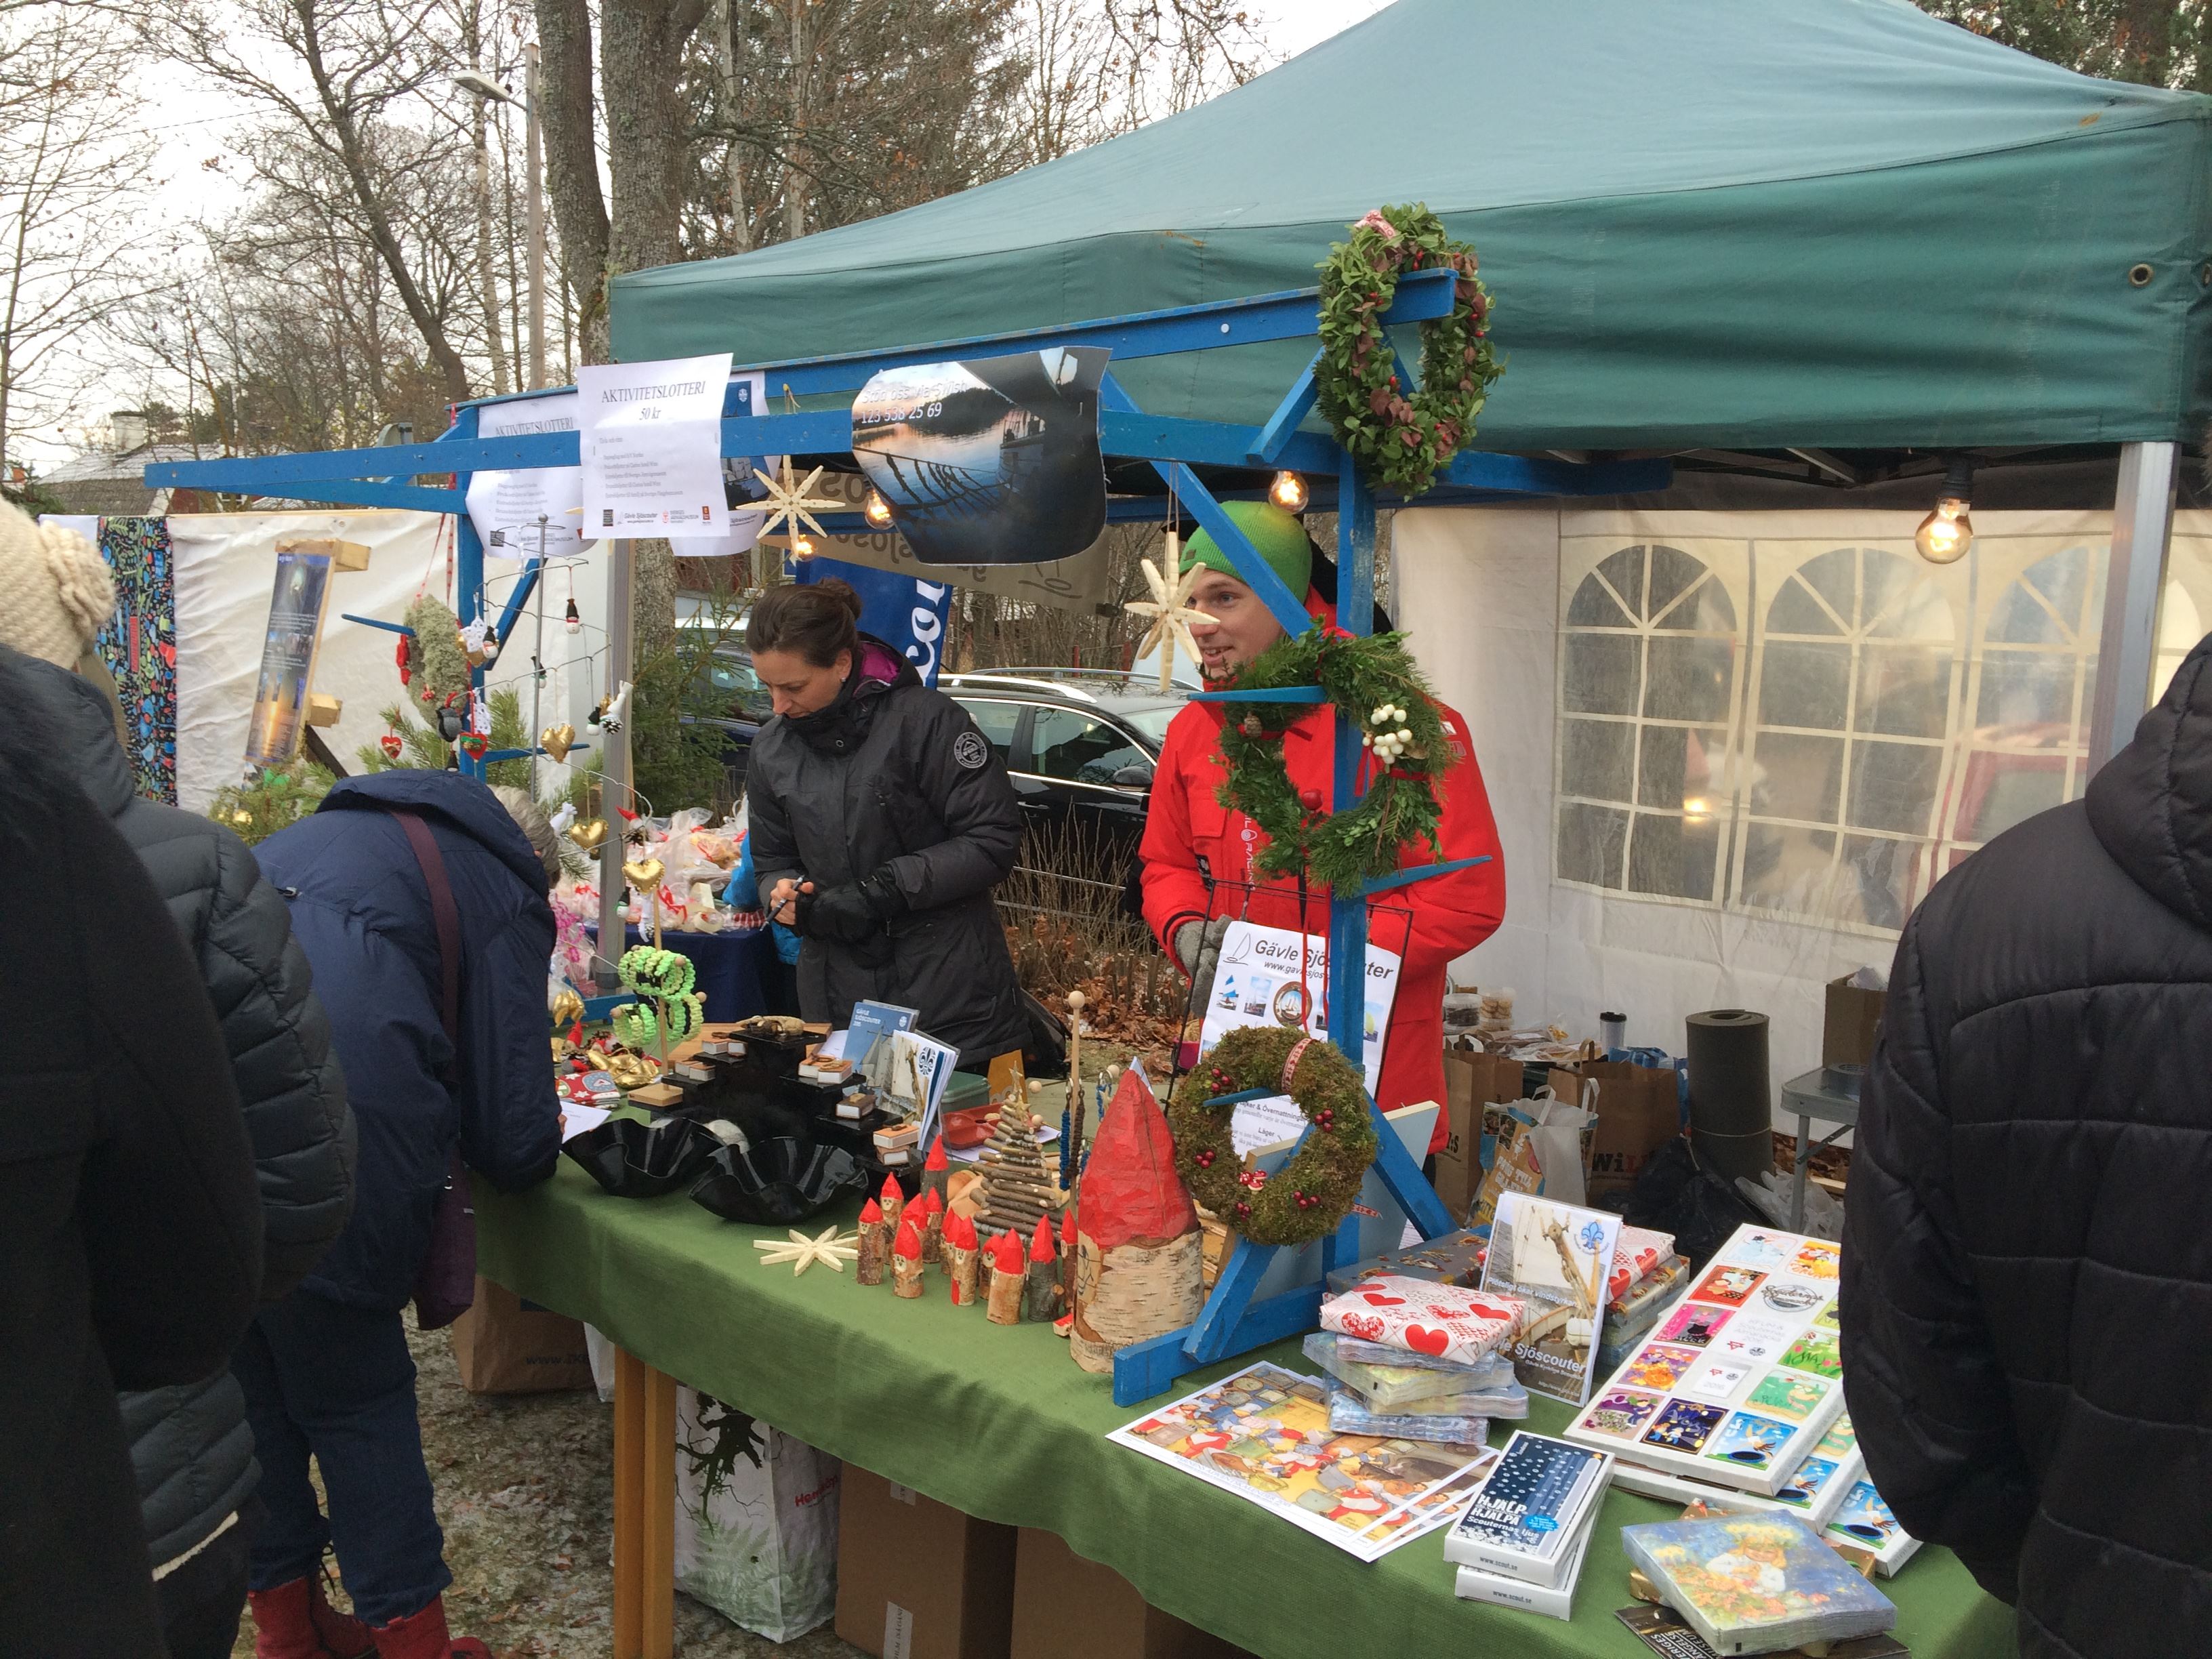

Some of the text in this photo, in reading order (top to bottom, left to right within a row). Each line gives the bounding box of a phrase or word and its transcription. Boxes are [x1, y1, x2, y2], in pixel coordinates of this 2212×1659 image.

[601, 380, 707, 403] AKTIVITETSLOTTERI
[639, 407, 662, 421] 50 kr
[861, 402, 943, 424] 123 538 25 69
[495, 417, 575, 437] AKTIVITETSLOTTERI
[1255, 939, 1299, 961] Gävle
[1258, 1127, 1275, 1138] Läger
[1515, 1342, 1586, 1374] Sjöscouter
[1477, 1493, 1528, 1515] HJÄLP
[1467, 1515, 1520, 1533] Scouternas
[1479, 1555, 1518, 1571] www.scout.se
[1492, 1590, 1532, 1604] www.scout.se
